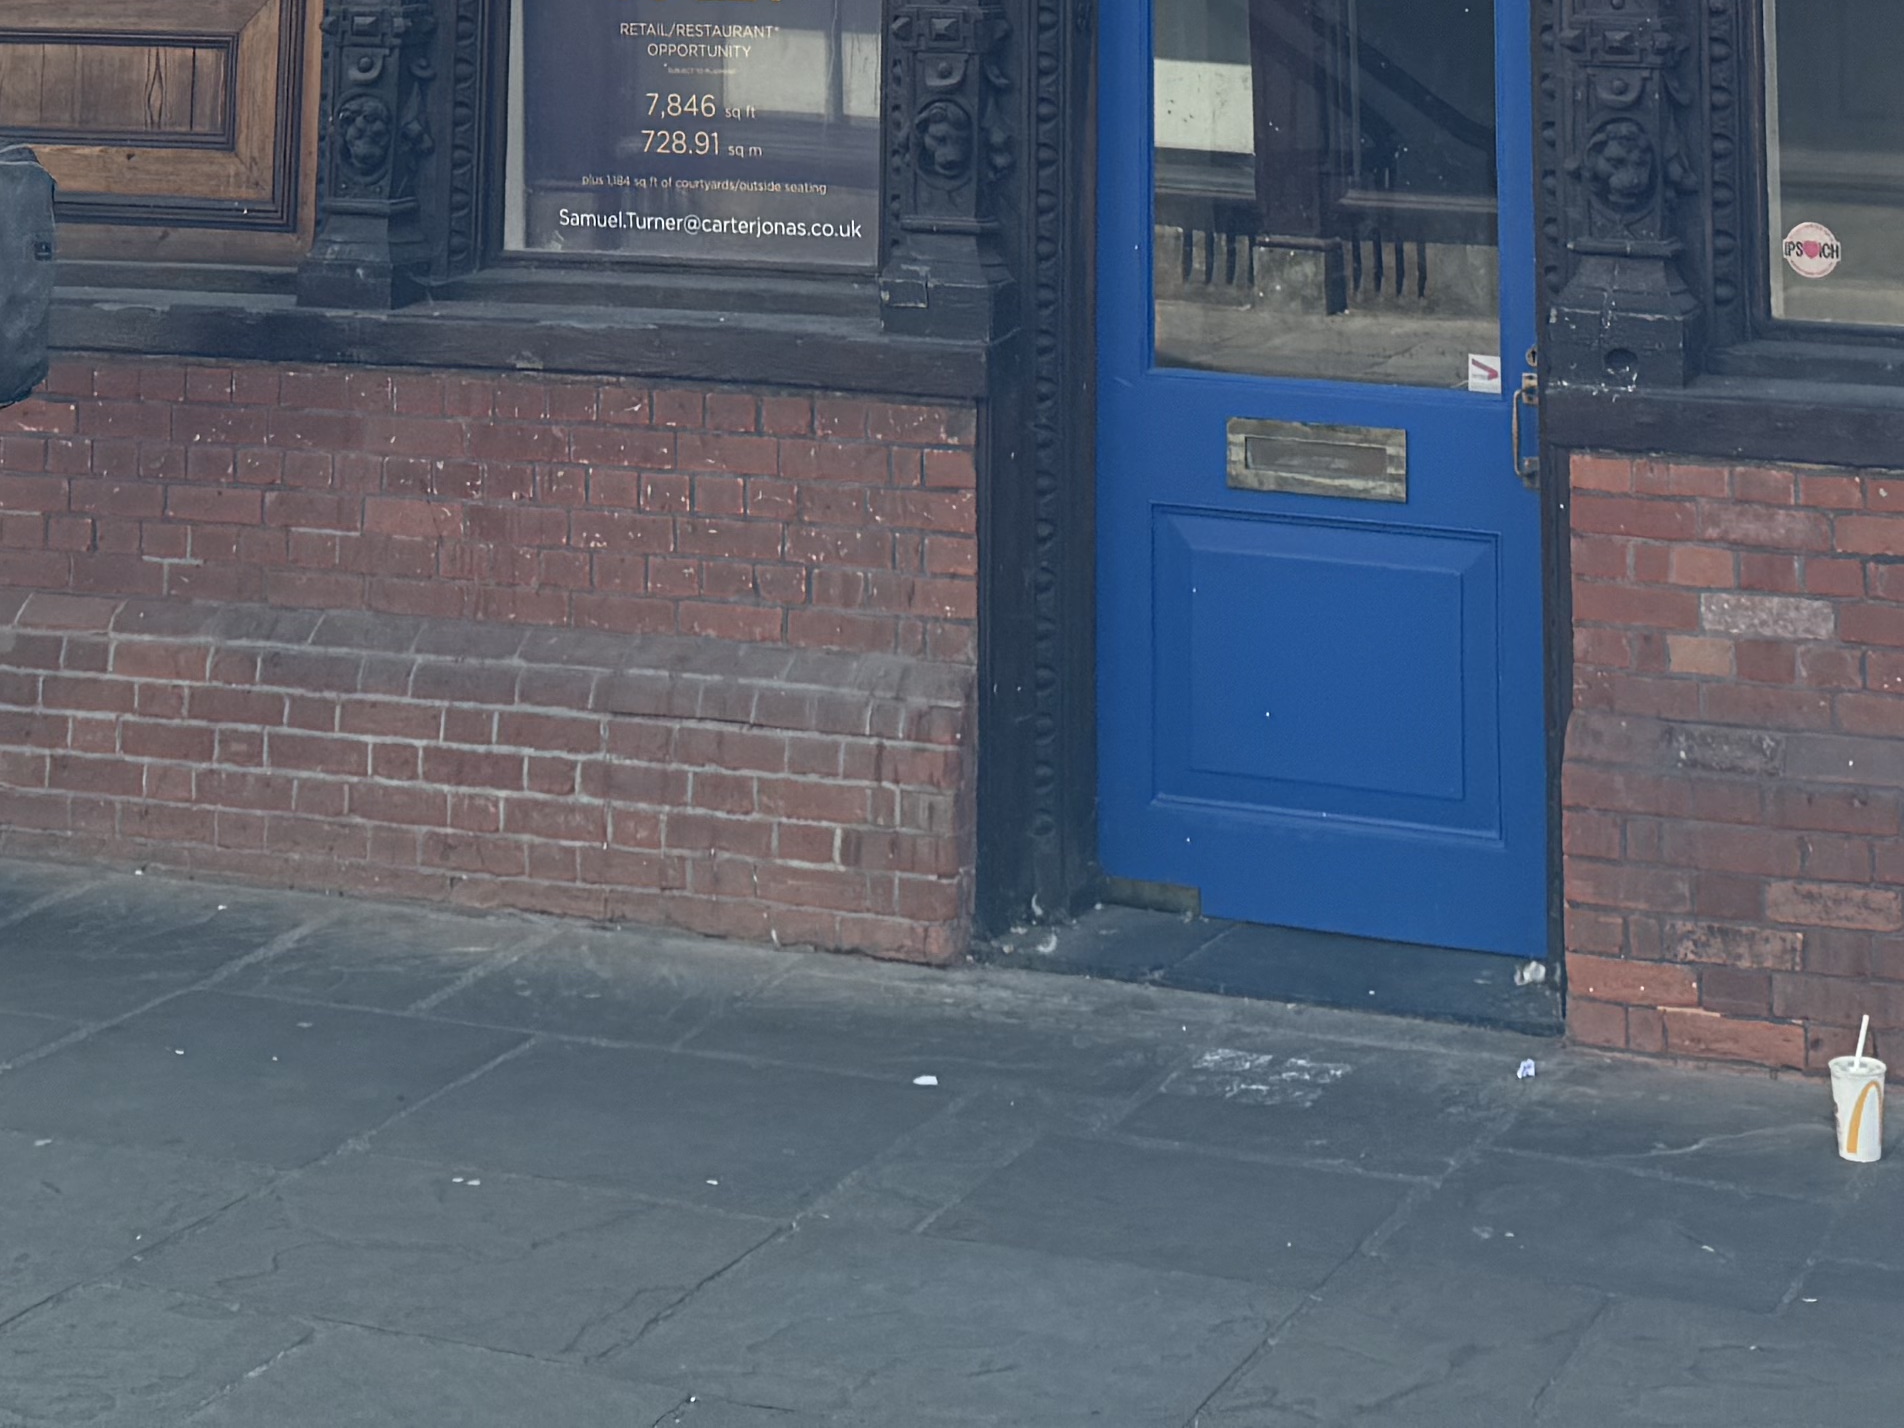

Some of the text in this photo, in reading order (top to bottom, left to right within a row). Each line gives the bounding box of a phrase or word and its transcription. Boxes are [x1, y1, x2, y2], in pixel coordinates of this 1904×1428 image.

[647, 43, 752, 59] OPPORTUNITY
[645, 93, 757, 121] 7,846 sq ft
[640, 129, 762, 158] 728.91 sq m
[582, 174, 604, 186] plus
[634, 178, 646, 189] sq
[649, 176, 658, 188] ft
[661, 176, 672, 188] of
[675, 178, 782, 193] courtyards/outside
[784, 181, 827, 195] seating
[558, 208, 862, 239] Samuel.Turner@carterjonas.co.uk
